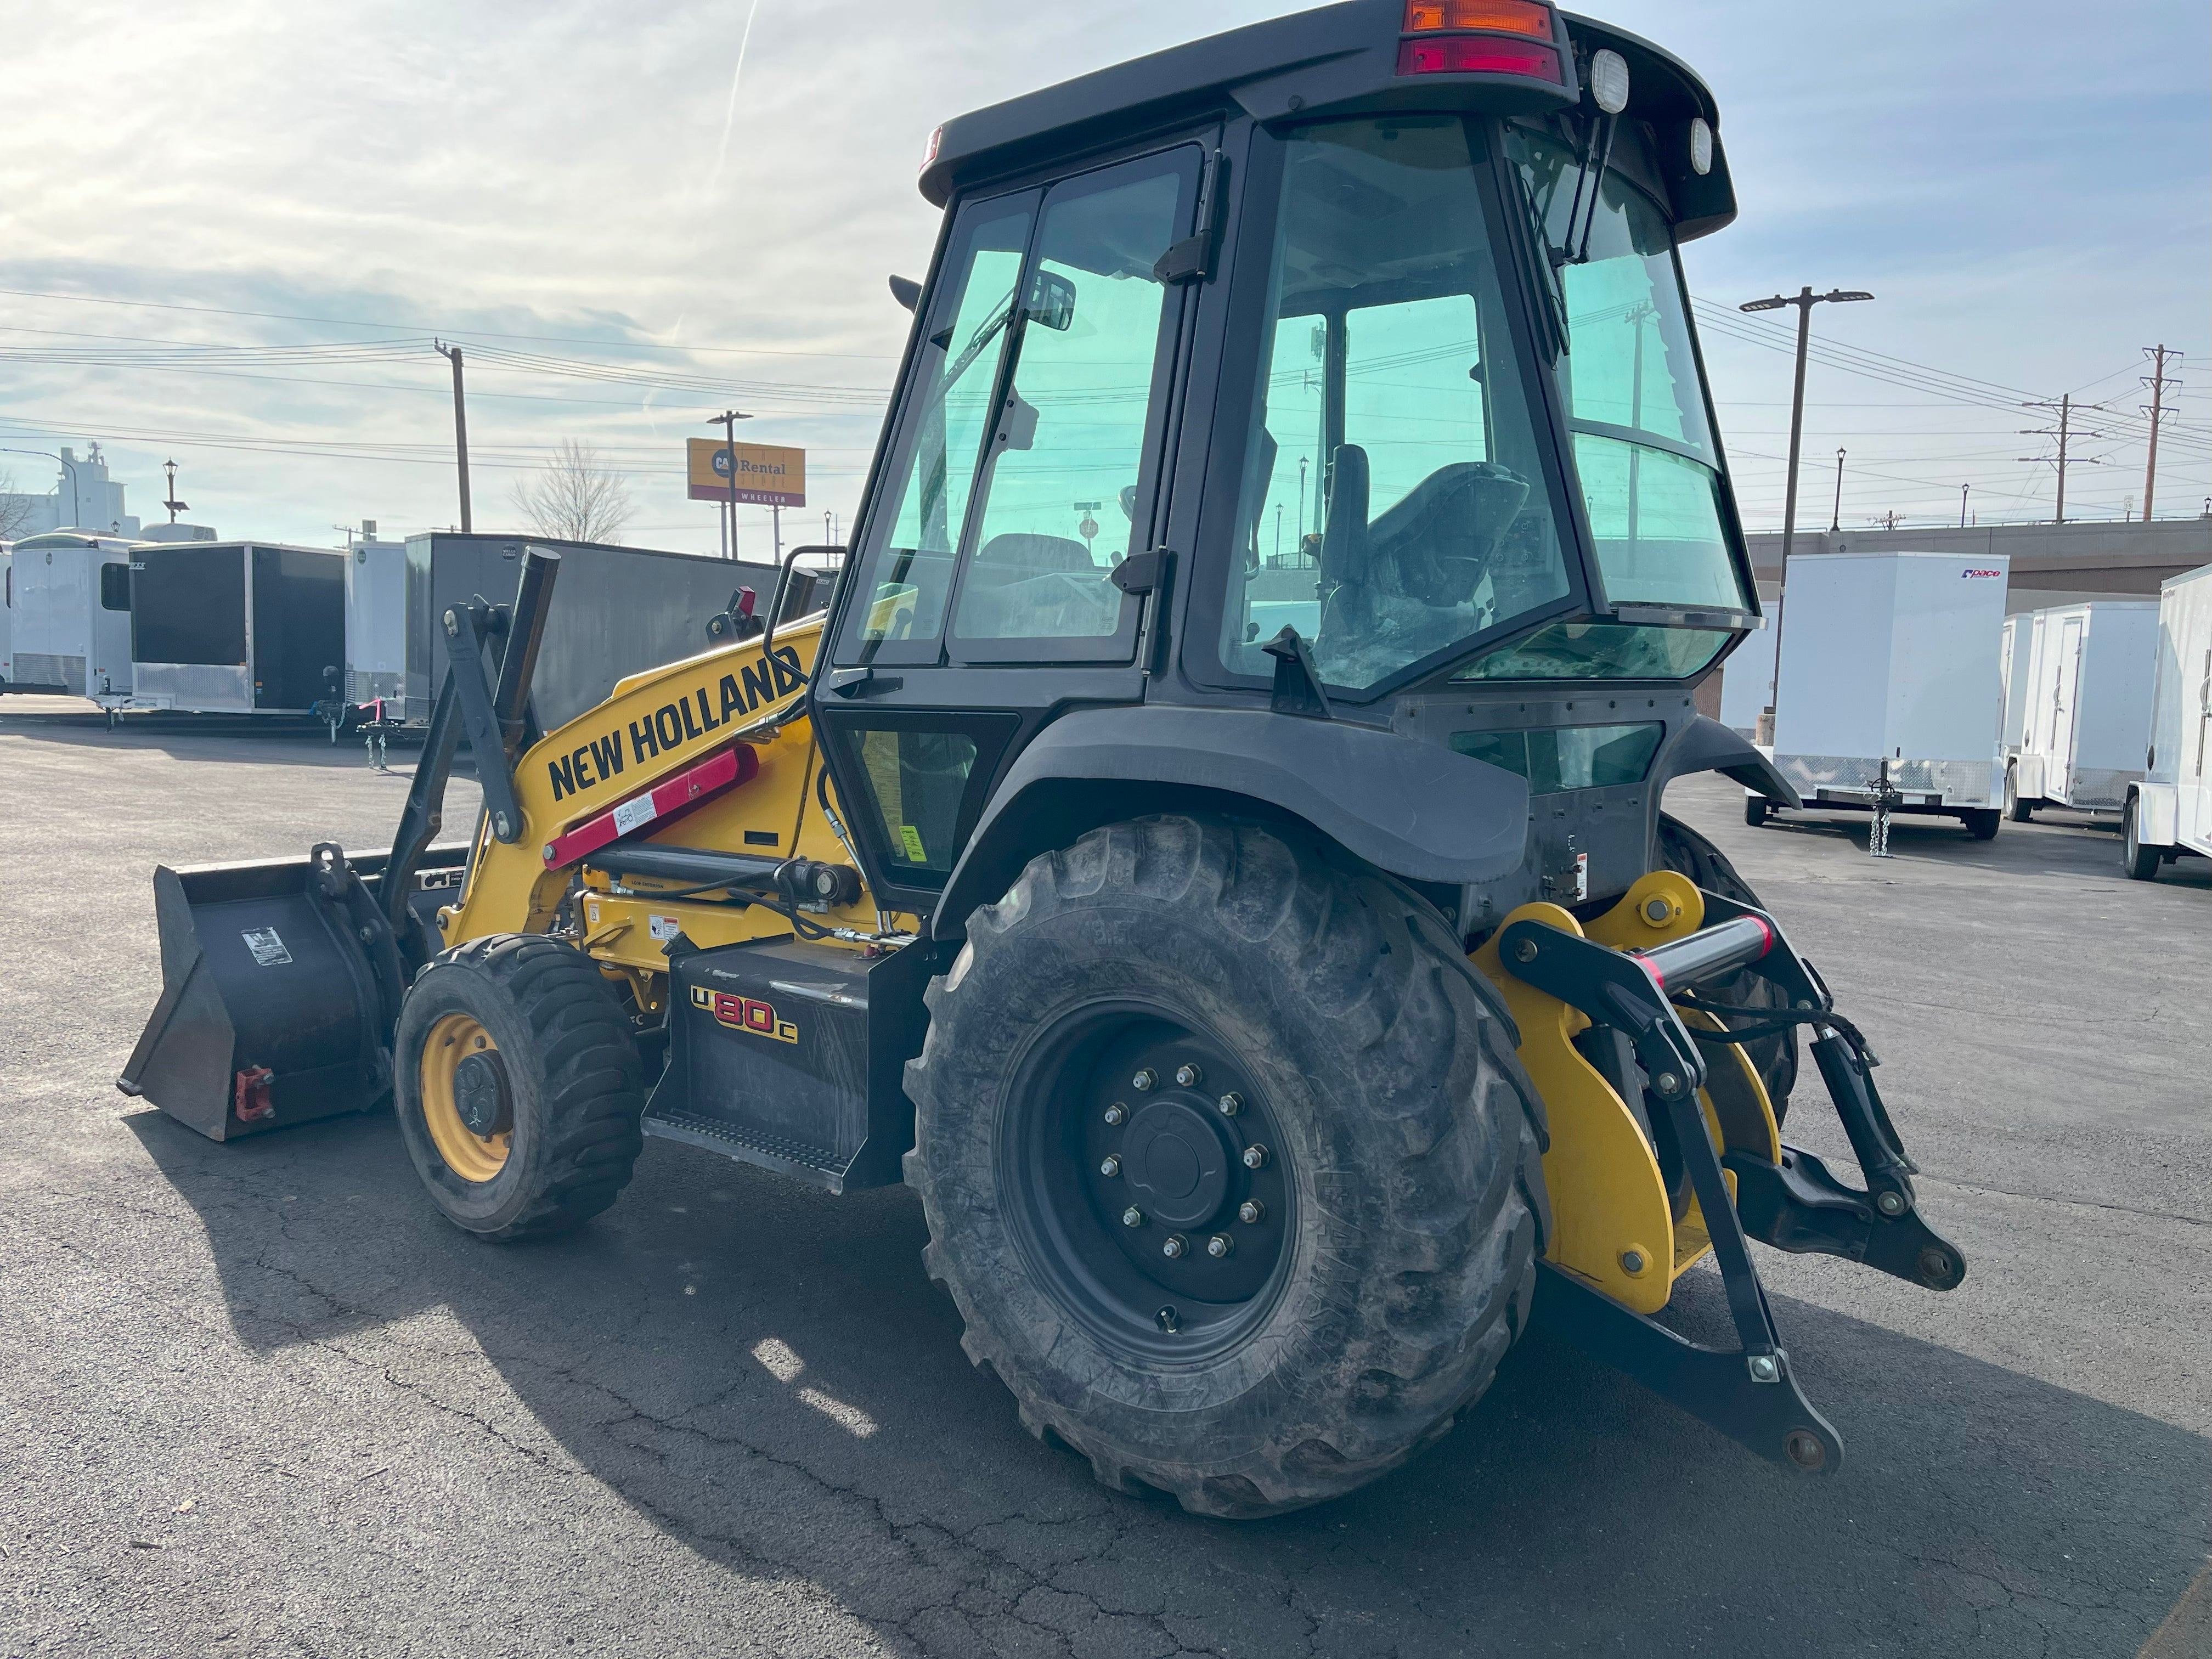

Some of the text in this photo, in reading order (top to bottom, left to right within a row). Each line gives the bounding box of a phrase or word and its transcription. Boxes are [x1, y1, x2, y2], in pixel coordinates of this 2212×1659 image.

[741, 447, 786, 462] THE
[715, 456, 730, 469] CA
[740, 460, 786, 475] Rental
[741, 474, 786, 488] STORE
[741, 493, 786, 503] WHEELER
[548, 646, 803, 802] NEW HOLLAND
[692, 987, 796, 1041] U80C
